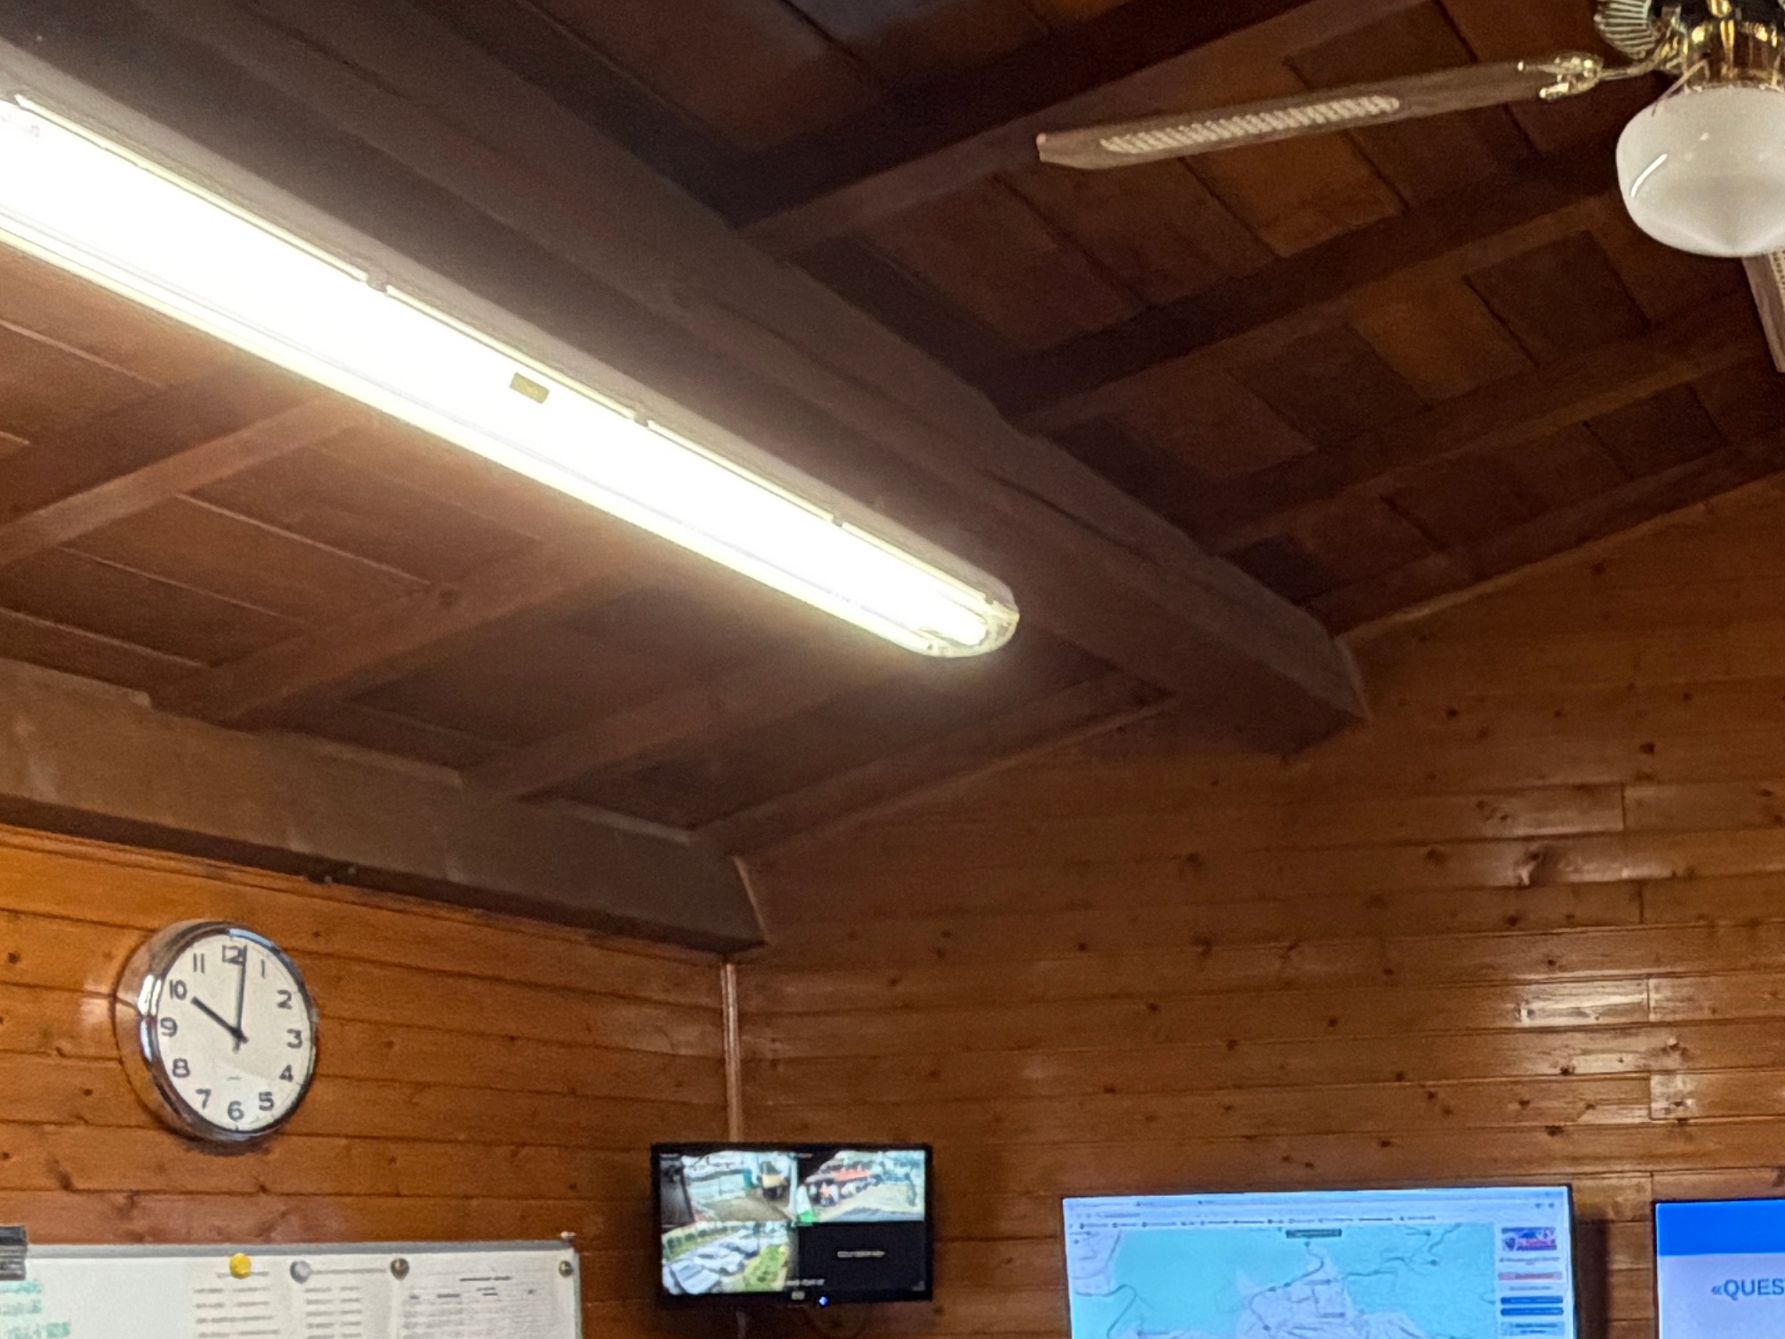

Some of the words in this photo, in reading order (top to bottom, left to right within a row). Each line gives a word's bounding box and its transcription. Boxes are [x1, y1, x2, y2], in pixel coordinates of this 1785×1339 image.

[193, 953, 205, 973] 11
[169, 979, 188, 1000] 10
[276, 990, 292, 1010] 2
[160, 1017, 178, 1037] 9
[286, 1029, 303, 1049] 3
[172, 1058, 190, 1078] 8
[279, 1064, 294, 1082] 4
[195, 1088, 212, 1110] 7
[258, 1092, 274, 1111] 5
[227, 1101, 245, 1121] 6
